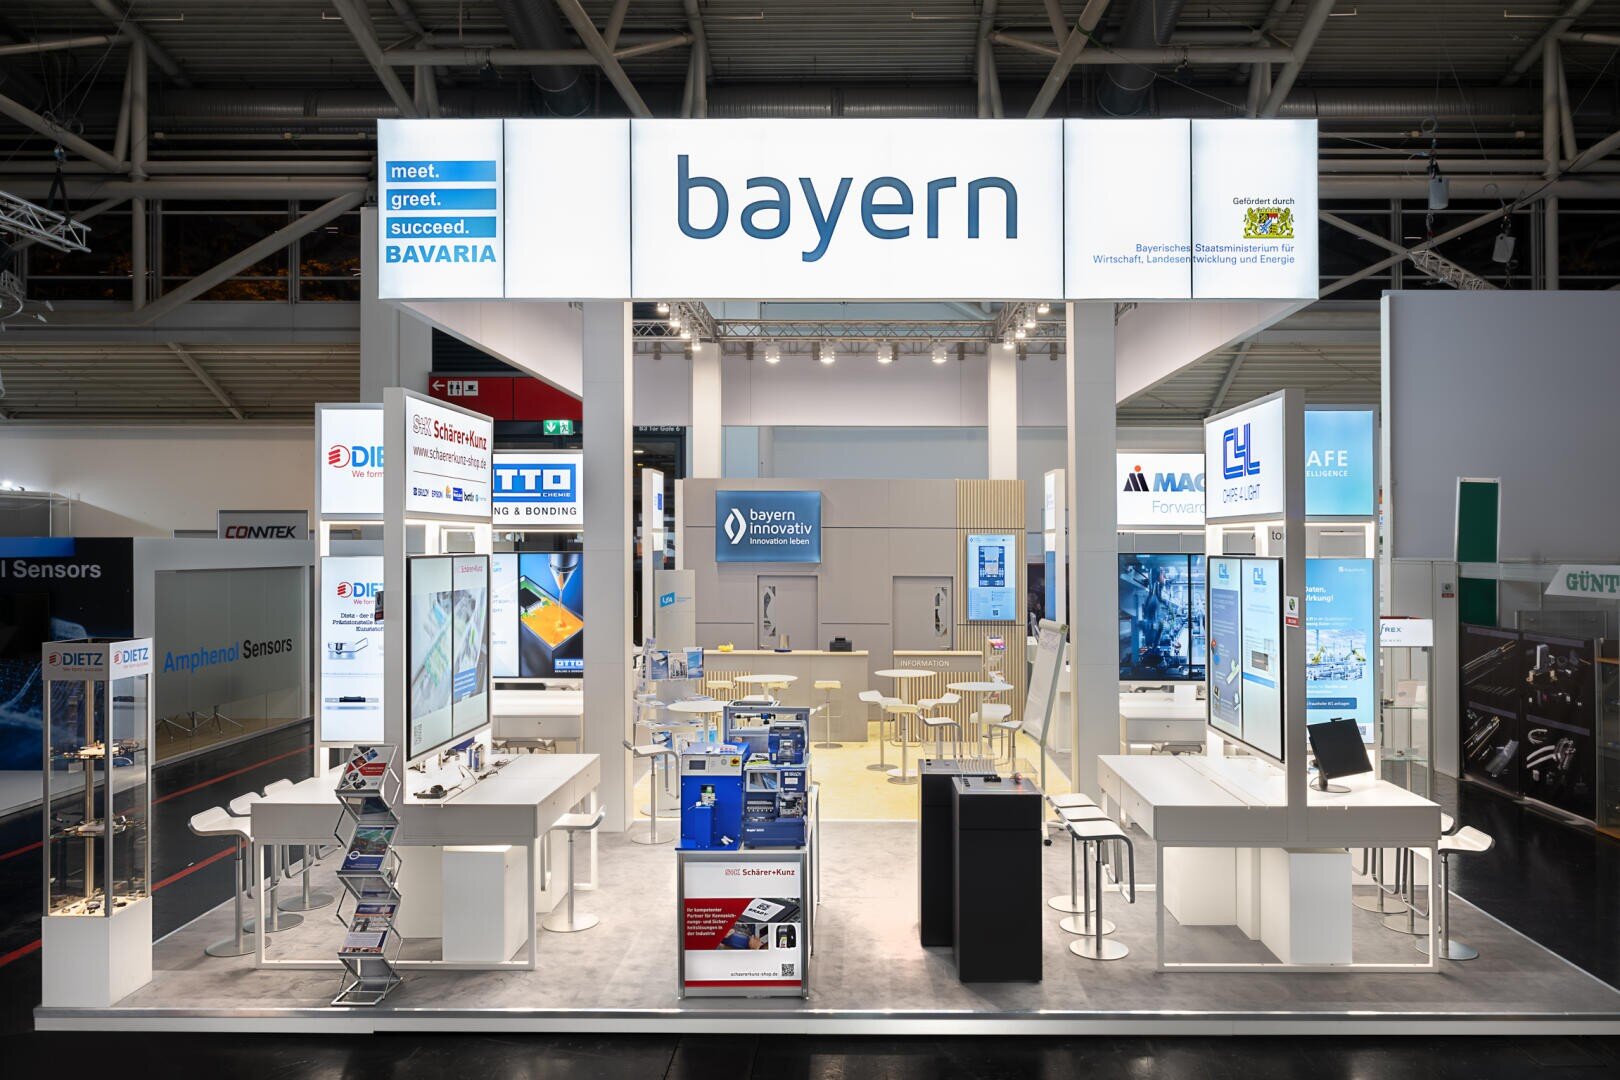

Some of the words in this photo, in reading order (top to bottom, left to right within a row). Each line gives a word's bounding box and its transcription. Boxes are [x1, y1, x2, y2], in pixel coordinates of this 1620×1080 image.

[391, 163, 440, 178] meet.
[391, 191, 442, 210] greet.
[677, 154, 1018, 262] bayern
[1232, 197, 1271, 205] Gefördert
[1272, 197, 1295, 205] durch
[391, 219, 470, 234] succeed.
[385, 244, 497, 263] BAVARIA
[1135, 243, 1191, 255] Bayerisches
[1195, 243, 1279, 253] Staatsministerium
[1281, 243, 1295, 253] für
[1093, 254, 1144, 265] Wirtschaft,
[1146, 254, 1237, 266] Landesentwicklung
[1239, 254, 1258, 264] und
[1260, 254, 1295, 265] Energie
[433, 419, 488, 451] Schärer+Kunz
[412, 445, 487, 470] www.schaererkunz-shop.de
[1306, 450, 1348, 467] AFE
[351, 470, 365, 478] We
[493, 469, 571, 490] TTO
[513, 506, 521, 516] &
[525, 506, 577, 516] BONDING
[750, 508, 795, 524] bayern
[225, 525, 297, 539] CONNTEK
[750, 522, 812, 535] innovativ
[750, 537, 788, 545] Innovation
[789, 537, 810, 545] leben
[12, 559, 102, 579] Sensors
[1566, 570, 1620, 593] GÜNT
[353, 582, 384, 598] DIE
[63, 652, 103, 666] DIETZ
[123, 647, 149, 663] DIETZ
[163, 641, 240, 673] Amphenol
[242, 637, 293, 659] Sensors
[900, 659, 950, 667] INFORMATION
[742, 868, 796, 876] Schärer+Kunz
